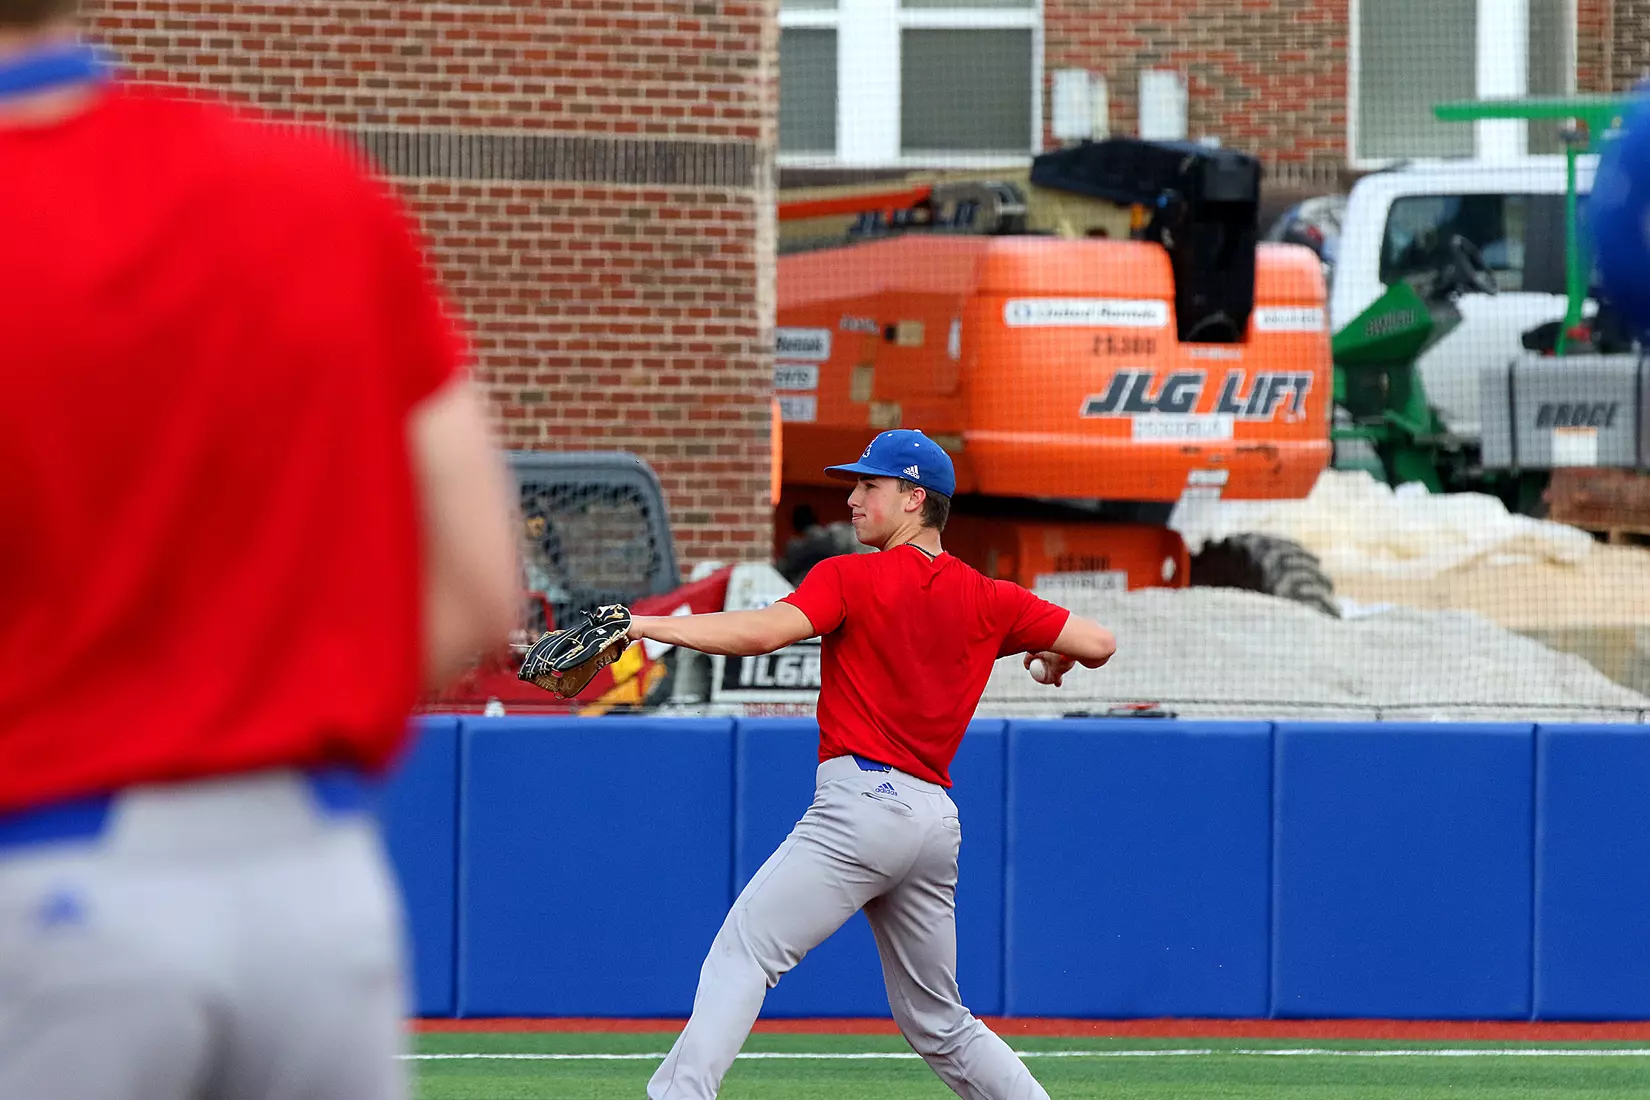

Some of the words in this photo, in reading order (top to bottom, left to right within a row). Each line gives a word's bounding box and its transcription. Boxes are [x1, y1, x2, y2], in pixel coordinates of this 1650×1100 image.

[1080, 370, 1206, 417] JLG
[1214, 370, 1313, 421] LIFT
[875, 787, 898, 797] adidas
